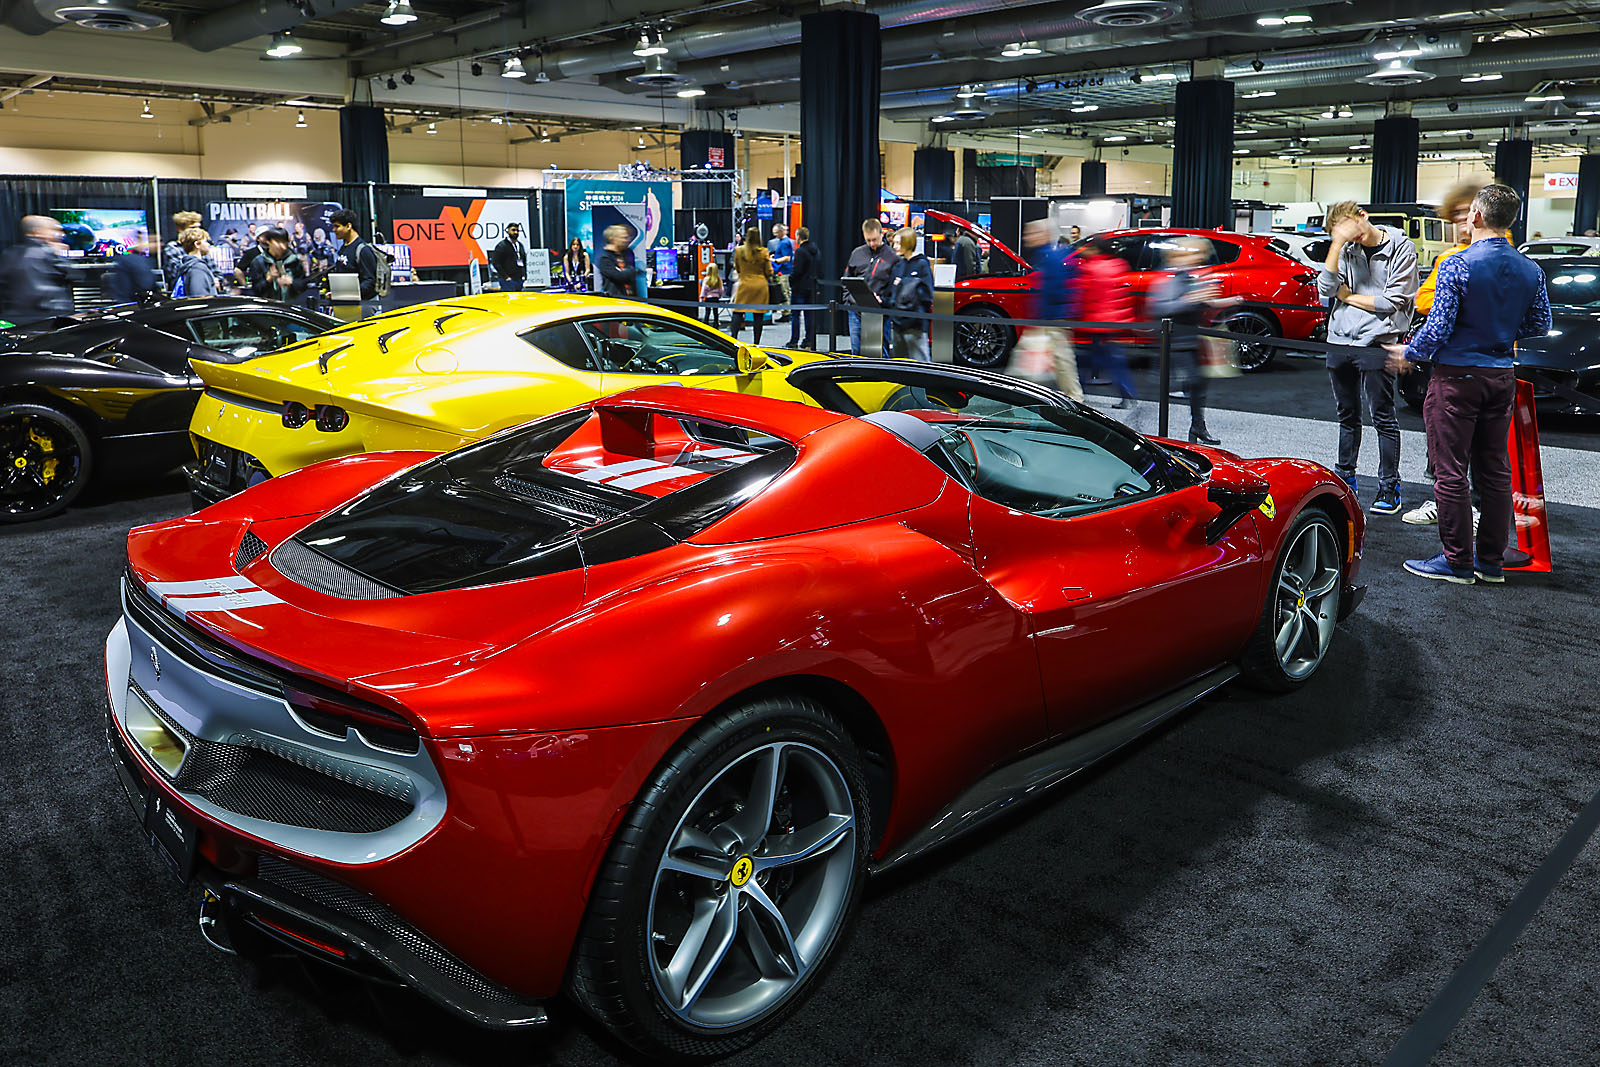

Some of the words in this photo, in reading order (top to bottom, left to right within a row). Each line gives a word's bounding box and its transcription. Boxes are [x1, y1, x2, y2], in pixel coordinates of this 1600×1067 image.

[1559, 177, 1578, 186] EXI
[210, 203, 293, 220] PAINTBALL
[397, 223, 445, 241] ONE
